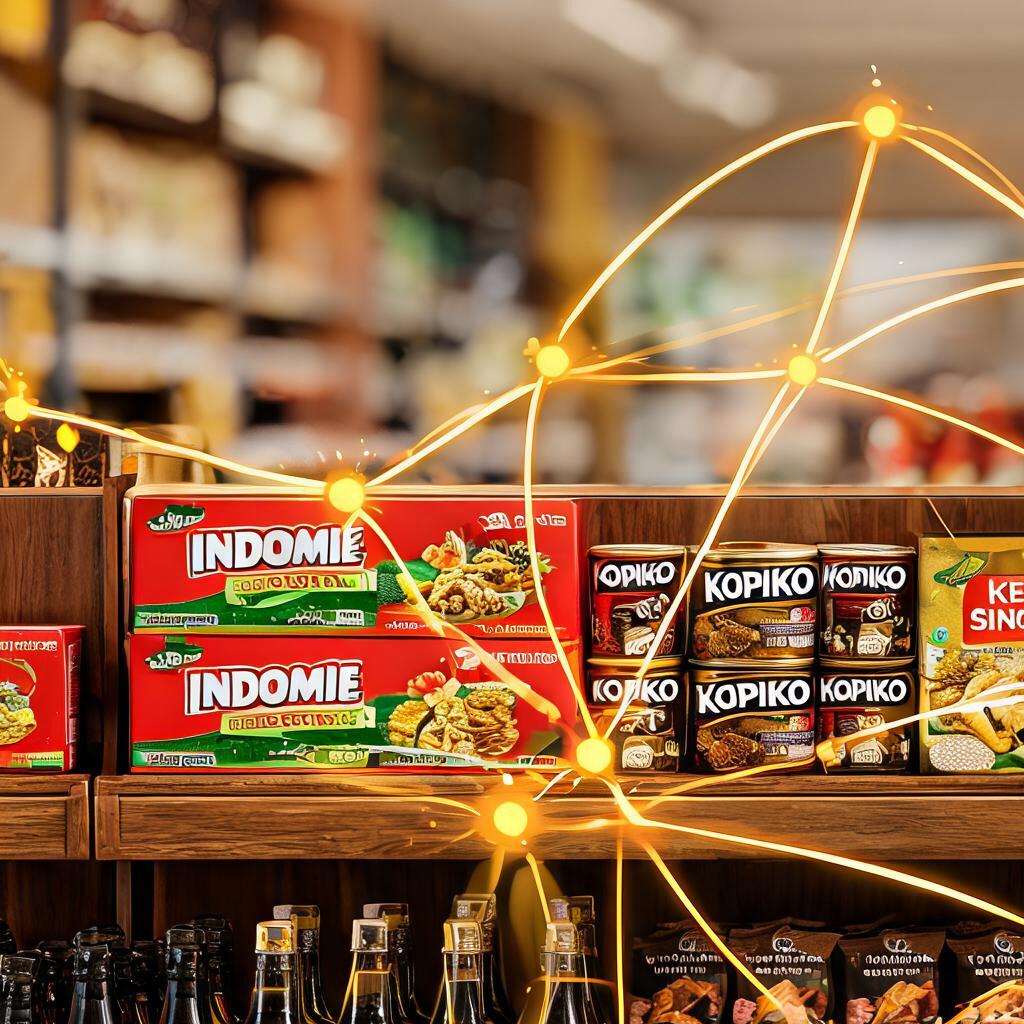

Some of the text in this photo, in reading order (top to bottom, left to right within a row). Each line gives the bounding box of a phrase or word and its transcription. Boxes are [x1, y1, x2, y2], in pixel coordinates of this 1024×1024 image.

[191, 526, 367, 573] INDOMIE
[705, 567, 814, 602] KOPIKO
[189, 664, 363, 715] INDOMIE
[697, 680, 811, 714] KOPIKO
[820, 677, 907, 703] KOPIKO
